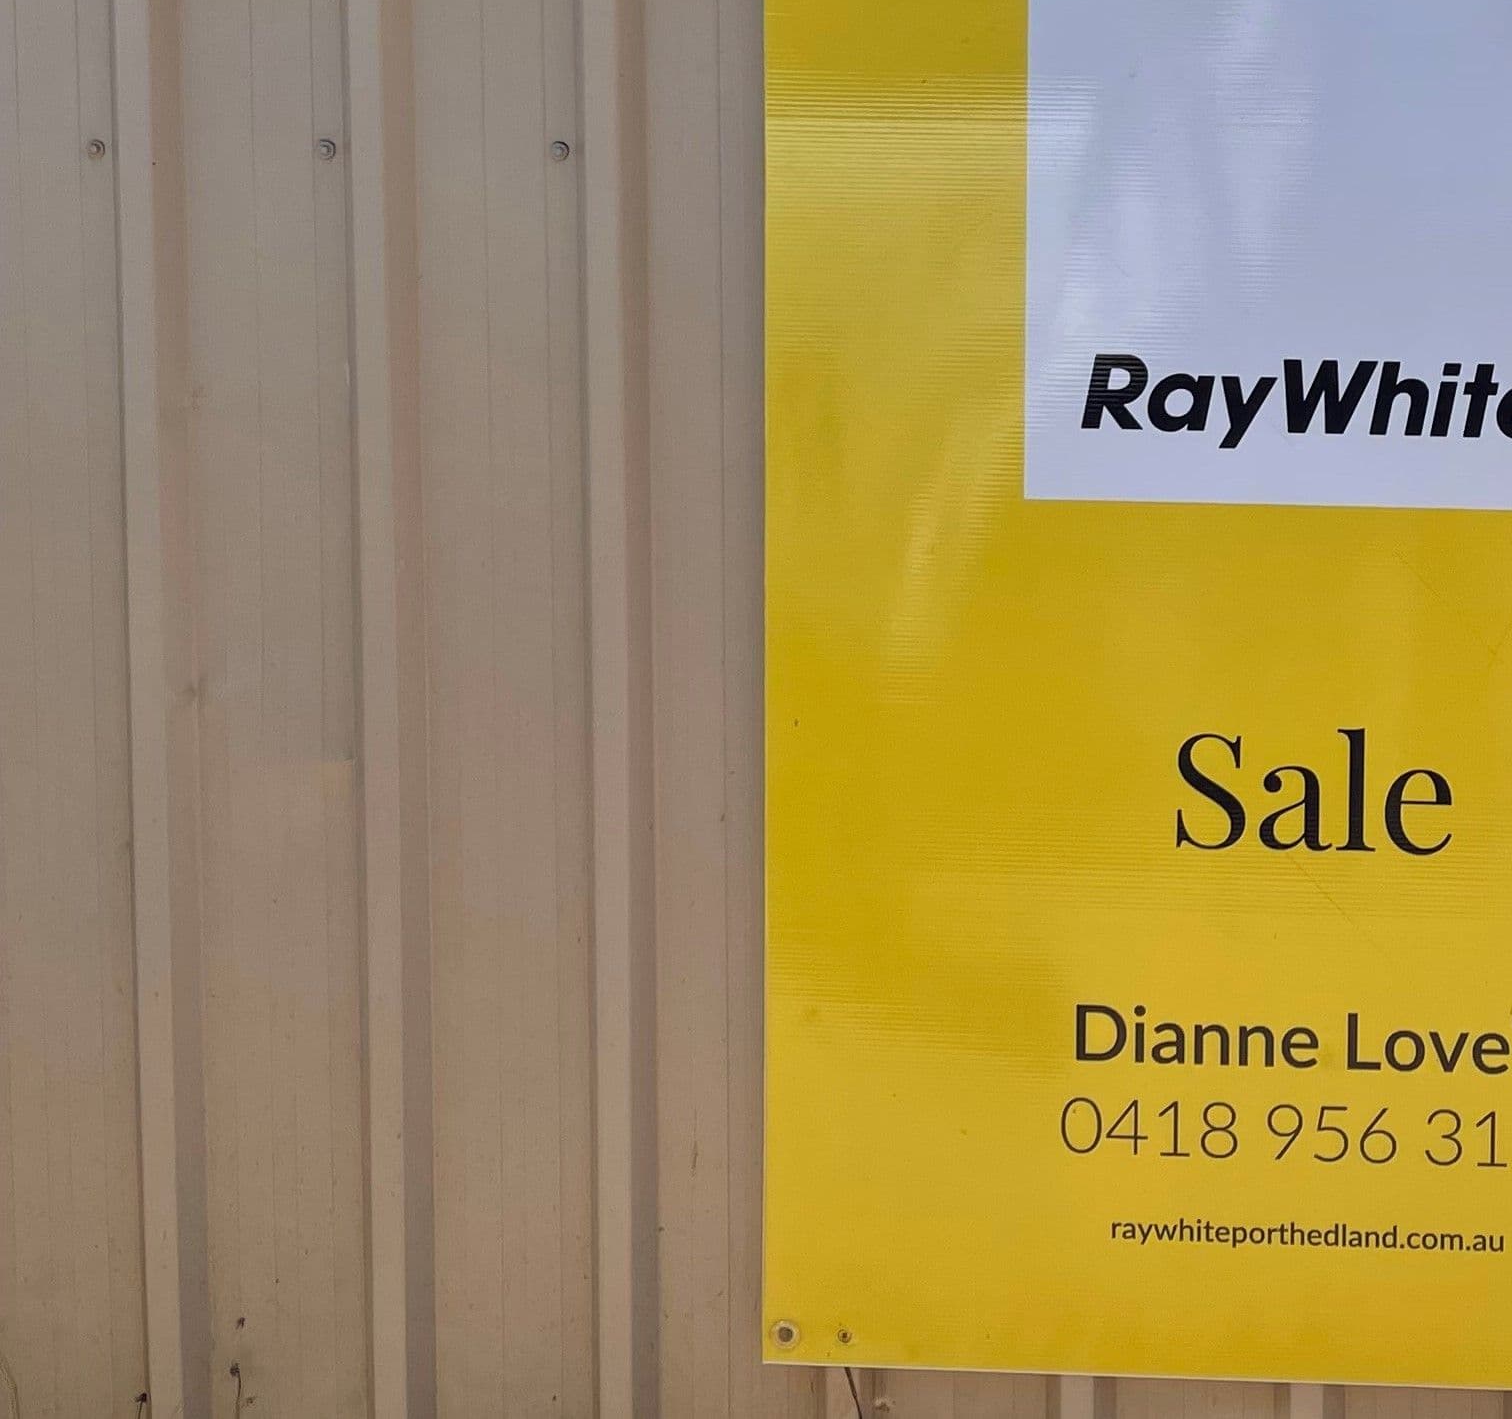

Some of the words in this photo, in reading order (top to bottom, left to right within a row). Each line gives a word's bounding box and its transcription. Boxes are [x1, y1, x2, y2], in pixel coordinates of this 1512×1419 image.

[1175, 727, 1453, 856] Sale
[1074, 1003, 1319, 1069] Dianne
[1060, 1096, 1238, 1159] 0418
[1266, 1103, 1398, 1164] 956
[1110, 1217, 1505, 1254] raywhiteporthedland.com.au
